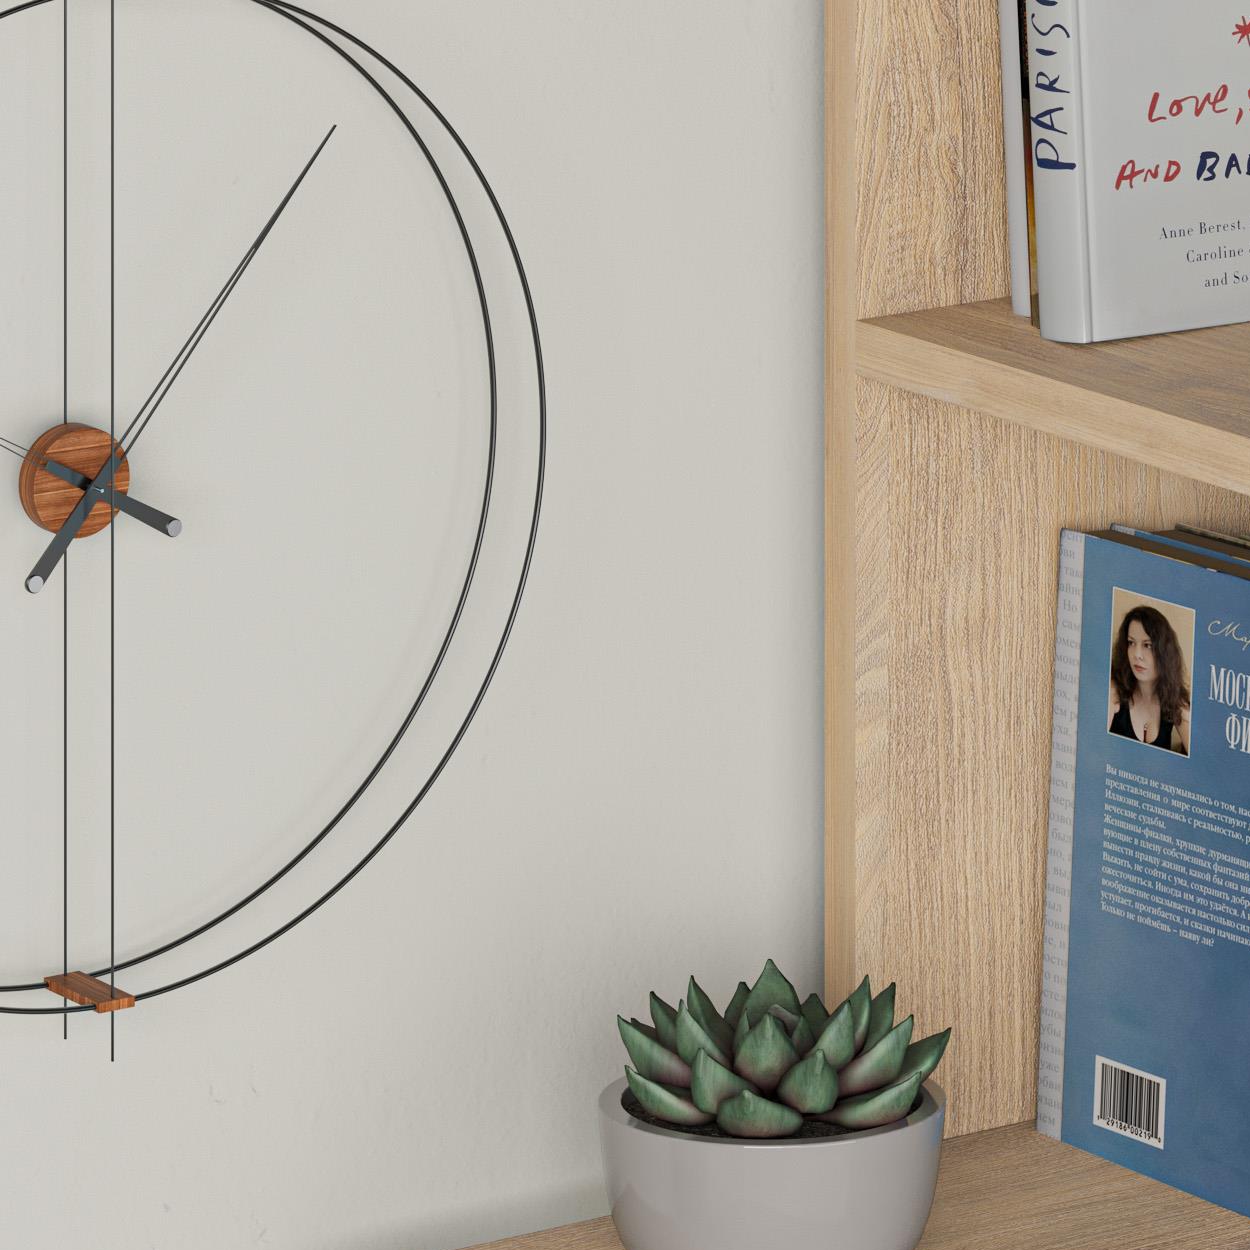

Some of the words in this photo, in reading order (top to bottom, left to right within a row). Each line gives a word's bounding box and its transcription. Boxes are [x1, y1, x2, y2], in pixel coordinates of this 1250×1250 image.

[1115, 160, 1181, 190] AND
[1159, 227, 1194, 240] Anne
[1186, 246, 1244, 263] Caroline
[1204, 272, 1228, 288] and
